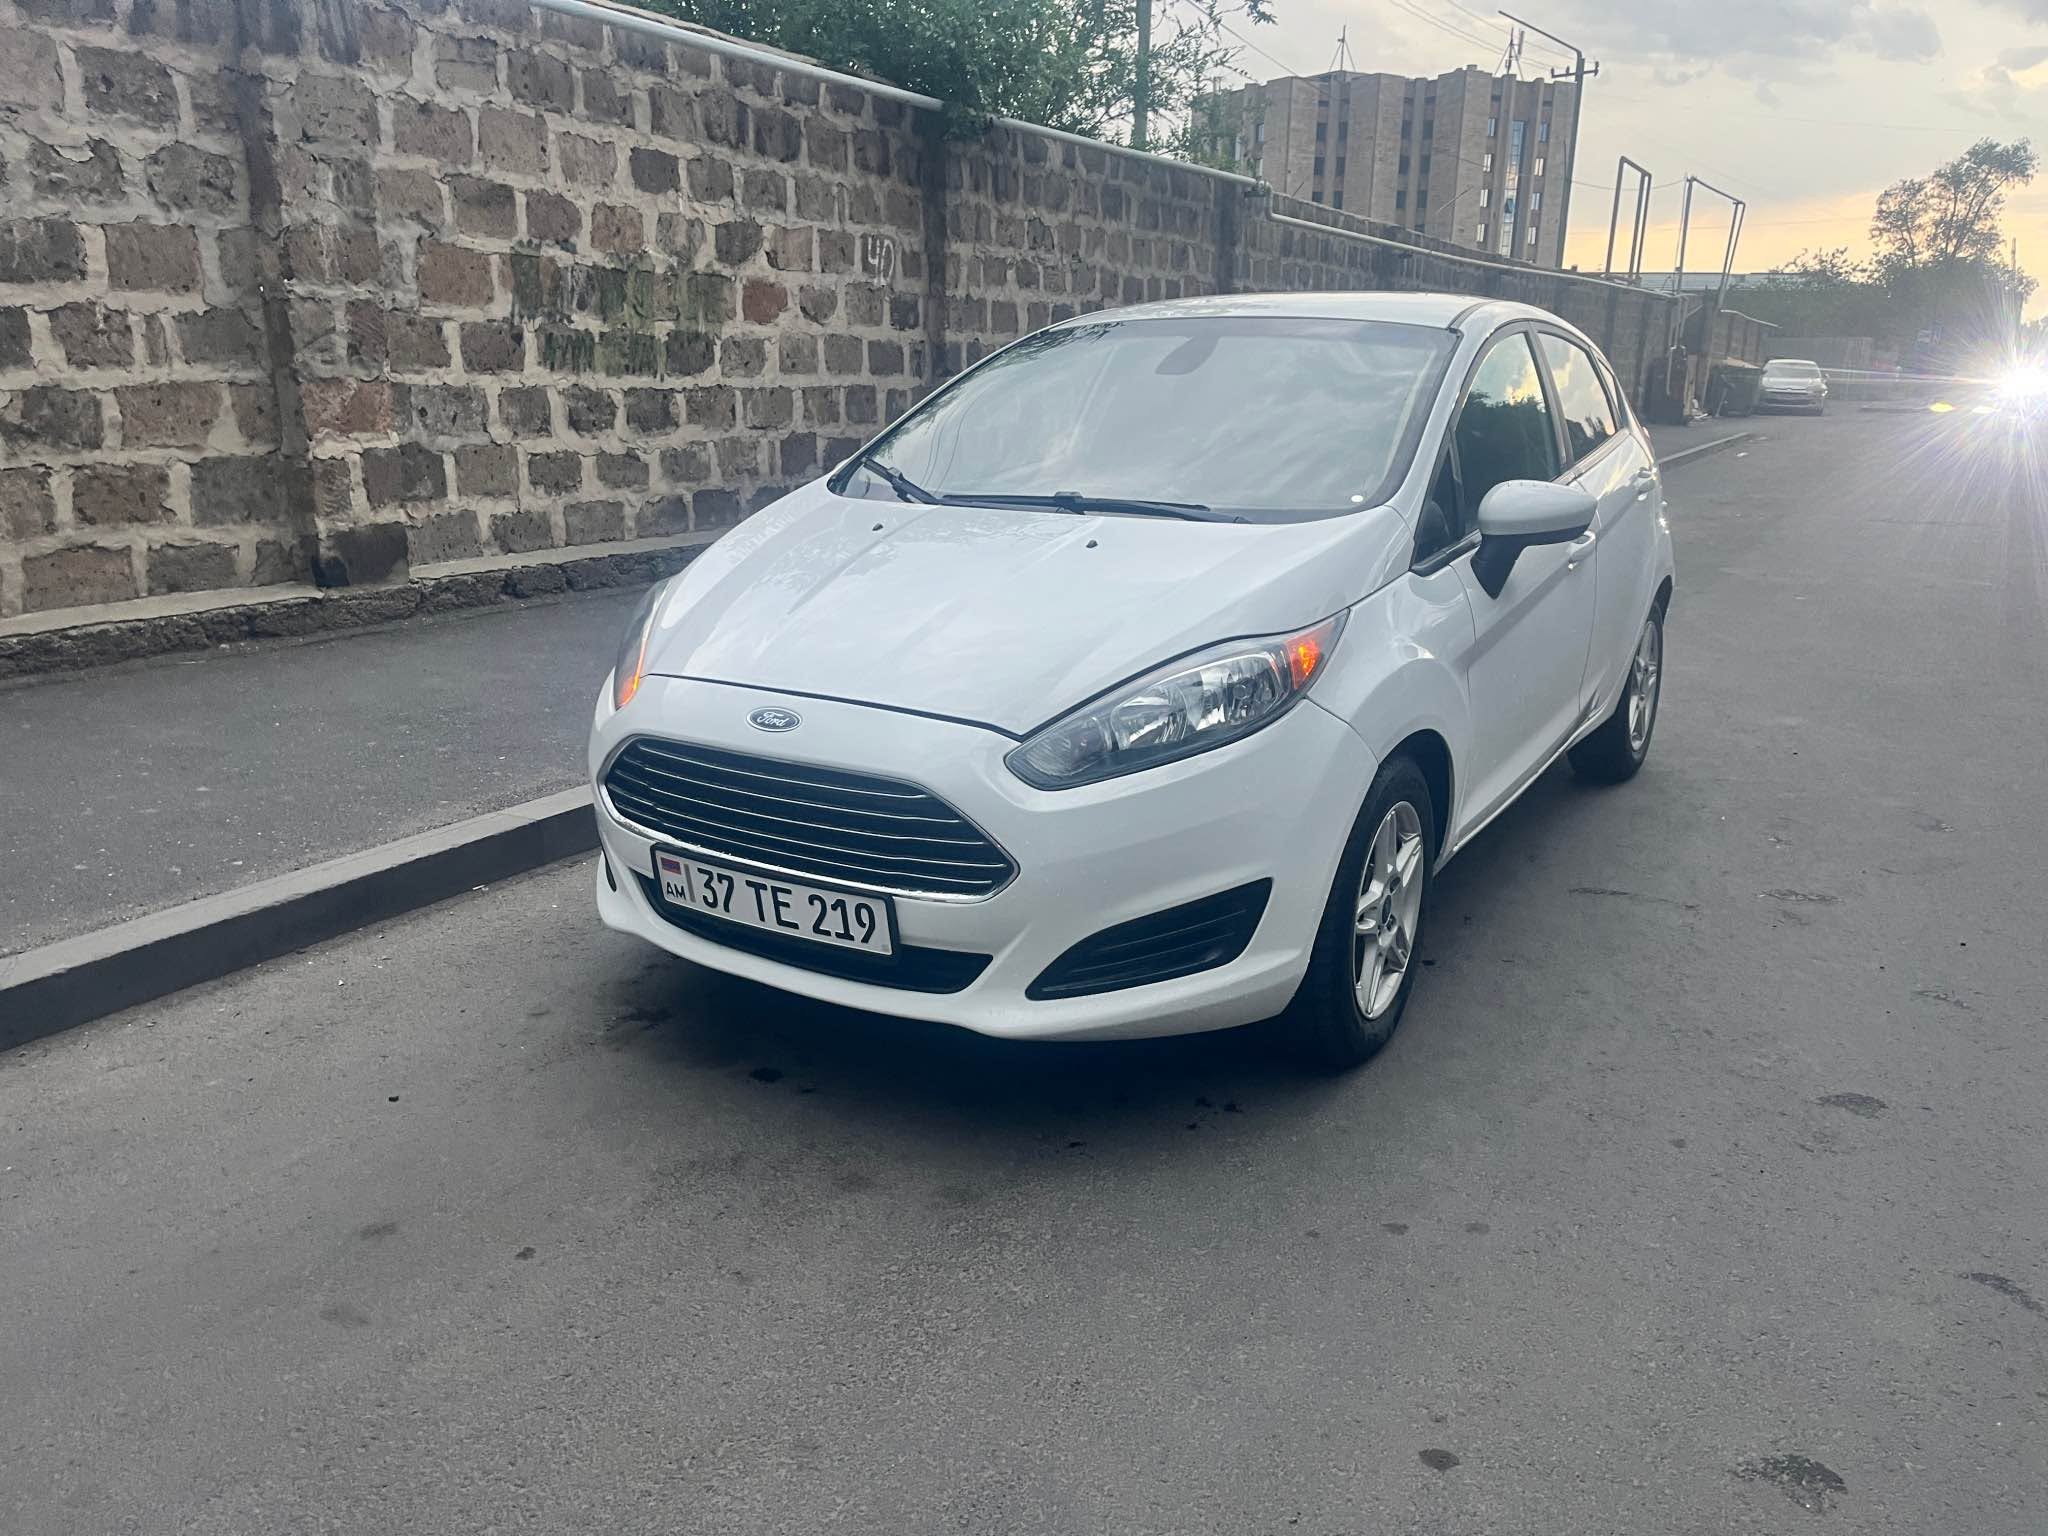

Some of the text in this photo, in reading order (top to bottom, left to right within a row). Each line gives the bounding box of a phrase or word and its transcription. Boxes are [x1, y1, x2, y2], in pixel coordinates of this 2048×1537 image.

[757, 711, 790, 727] Ford
[666, 881, 686, 901] AM
[697, 867, 876, 944] 37 TE 219
